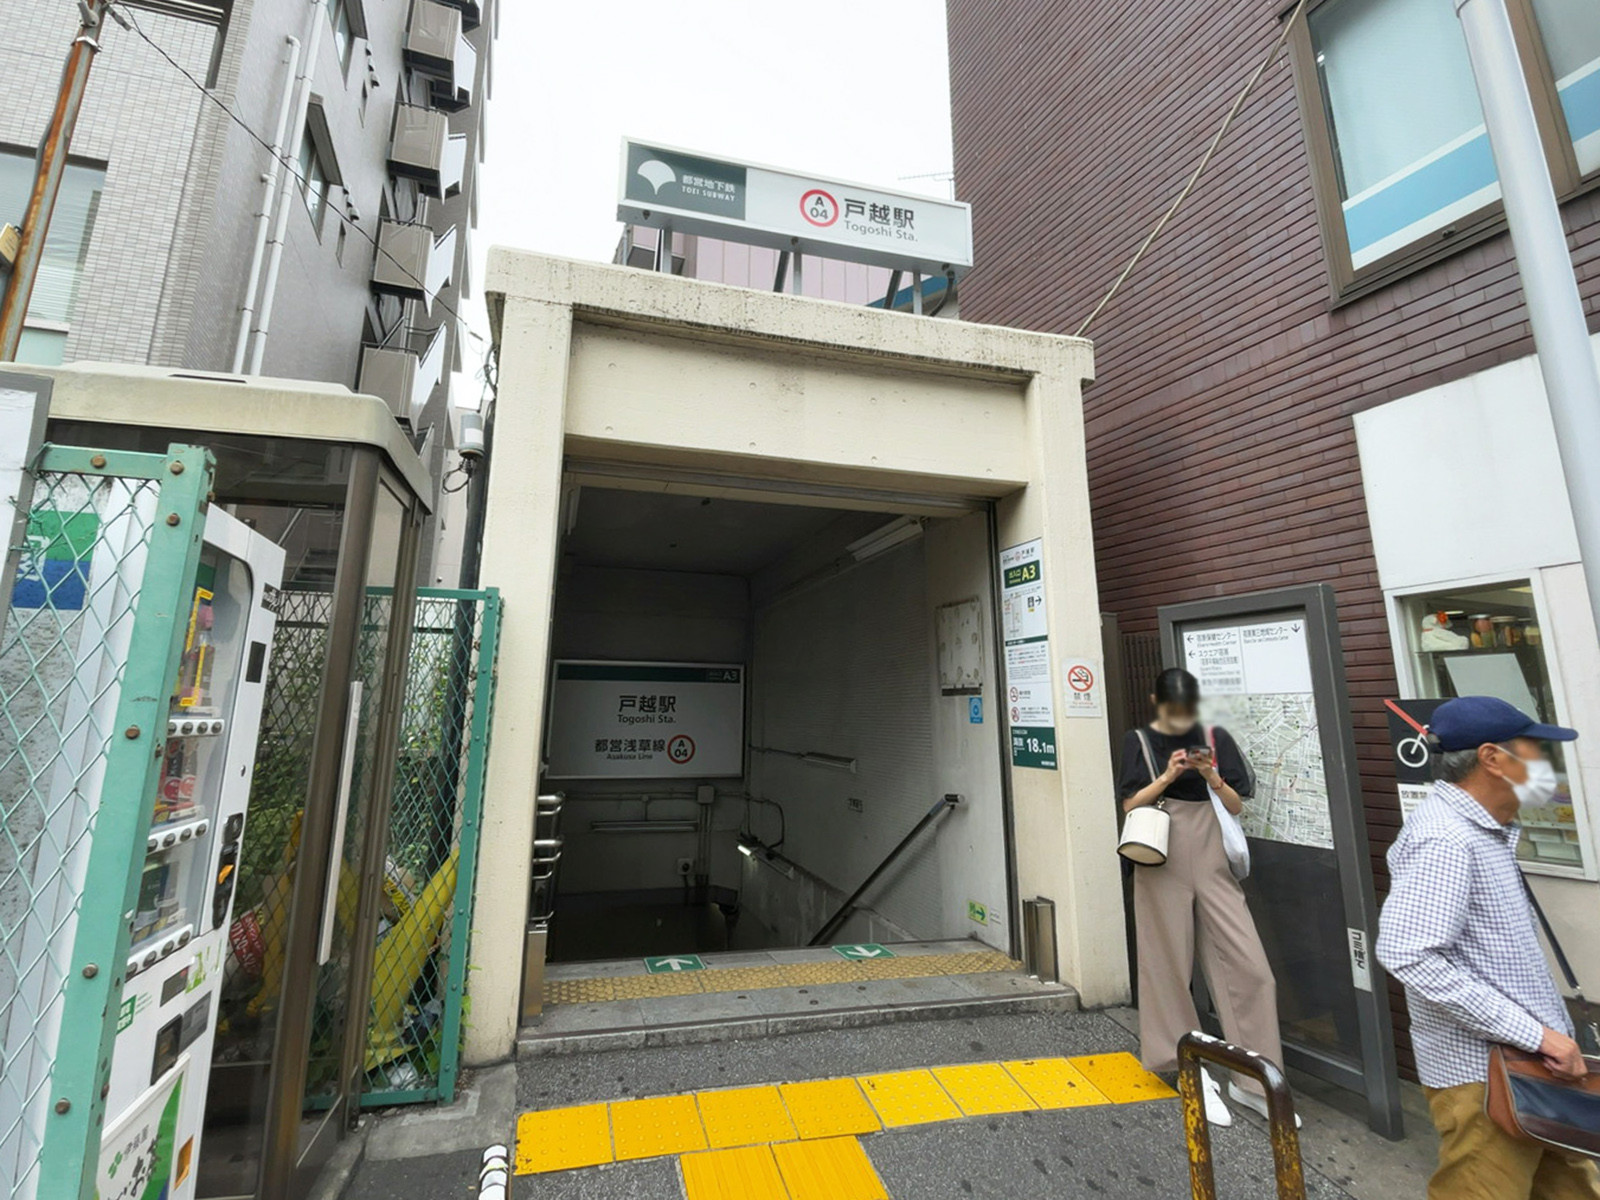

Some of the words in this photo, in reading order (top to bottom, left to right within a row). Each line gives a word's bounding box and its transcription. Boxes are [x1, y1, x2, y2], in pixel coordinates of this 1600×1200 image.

[682, 175, 735, 193] 都営地下鉄
[702, 190, 735, 202] SUBWAY
[814, 196, 825, 207] A
[810, 207, 828, 220] 04
[844, 198, 915, 230] 戸越駅
[844, 220, 892, 237] Togoshi
[896, 229, 919, 242] Sta.
[1022, 564, 1036, 581] A3
[723, 671, 737, 682] A3
[619, 695, 677, 713] 戸越駅
[618, 714, 655, 726] Togoshi
[658, 714, 677, 724] Sta.
[594, 739, 666, 752] 都営浅草線
[678, 740, 685, 748] A
[1027, 738, 1055, 754] 18.1m
[674, 749, 688, 758] 04
